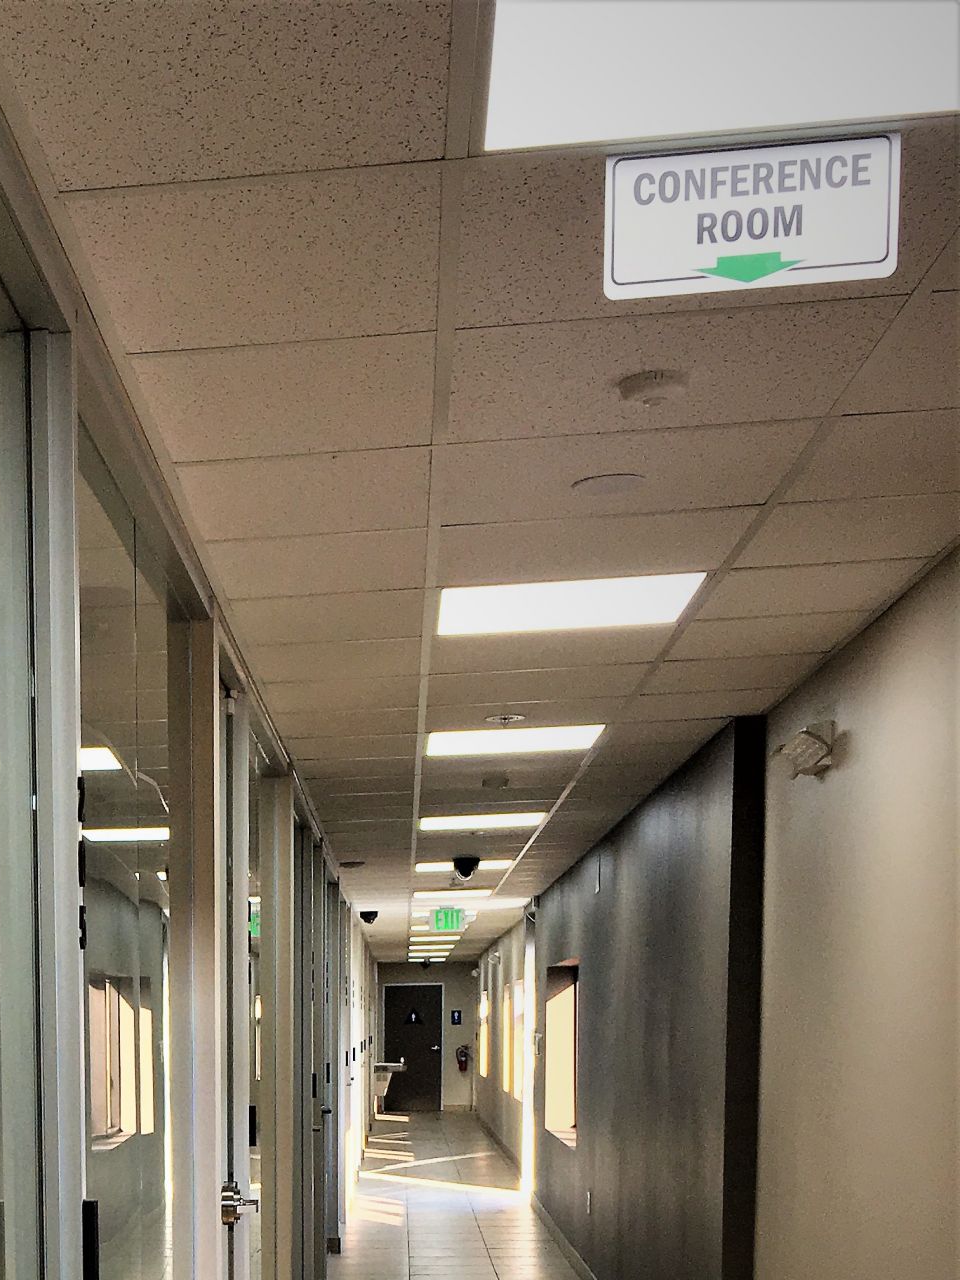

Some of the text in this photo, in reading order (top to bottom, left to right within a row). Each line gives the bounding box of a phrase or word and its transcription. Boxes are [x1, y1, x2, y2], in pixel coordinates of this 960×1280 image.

[632, 153, 872, 206] CONFERENCE
[696, 204, 803, 245] ROOM
[435, 909, 461, 930] EXIT
